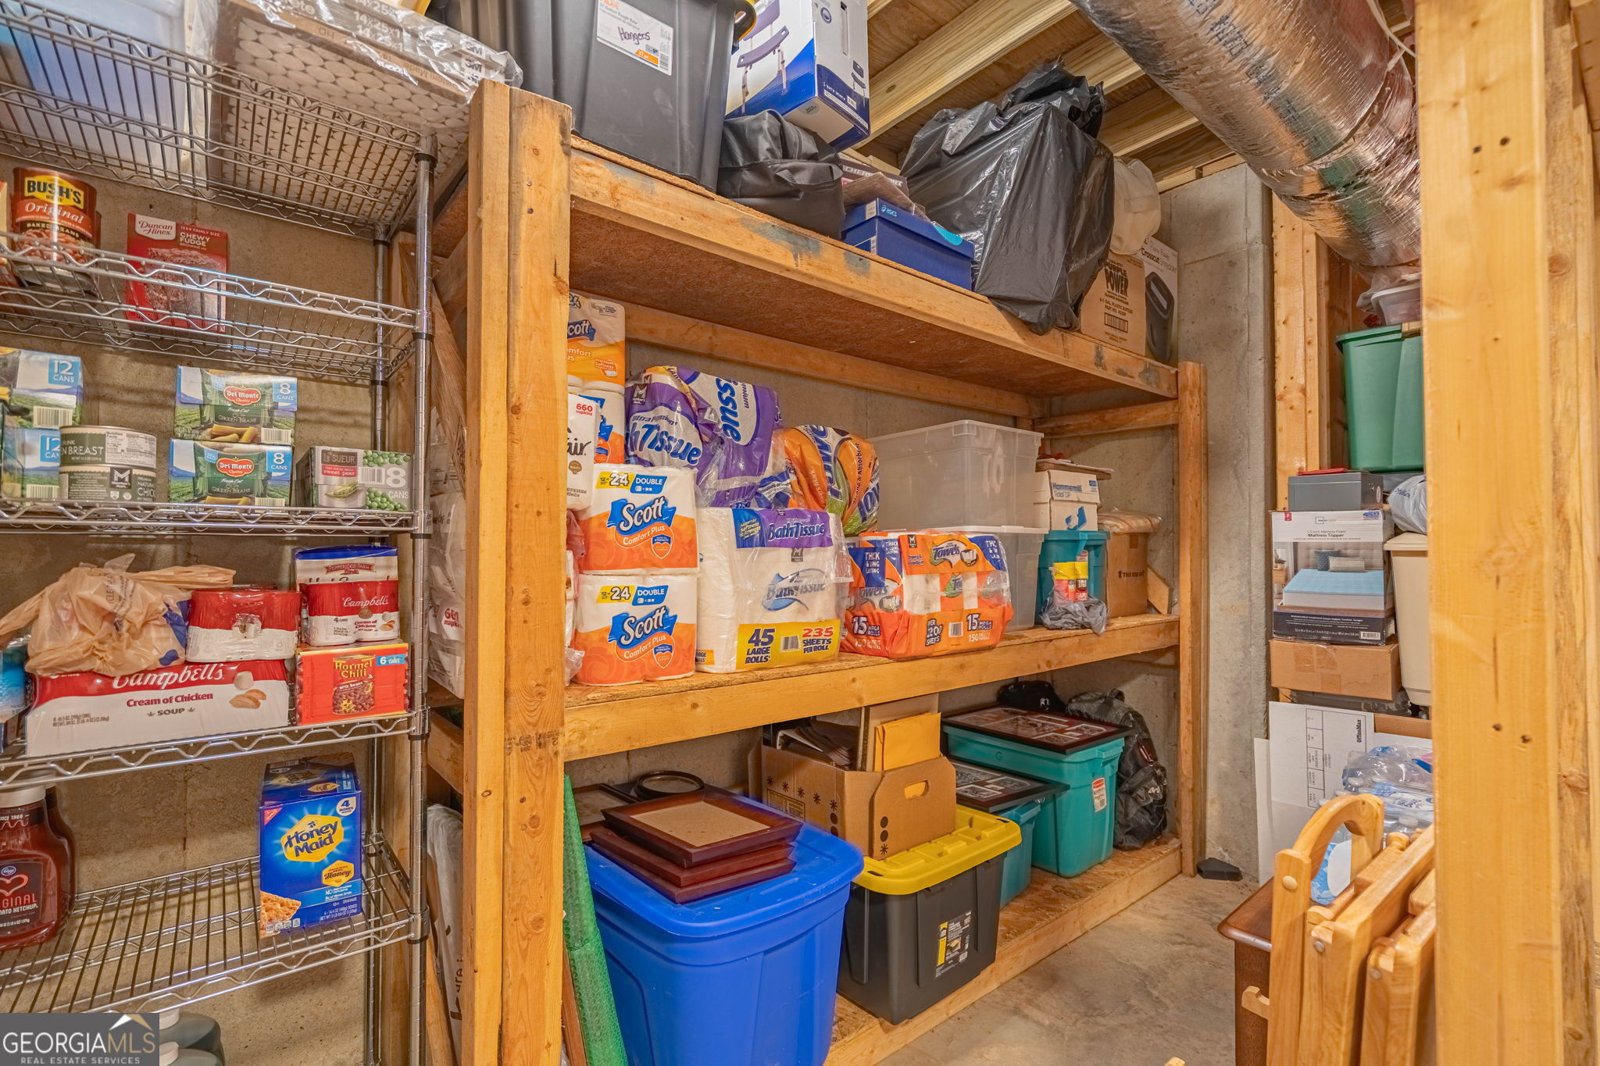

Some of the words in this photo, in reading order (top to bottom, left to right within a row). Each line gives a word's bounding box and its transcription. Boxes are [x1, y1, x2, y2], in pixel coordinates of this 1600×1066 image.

[617, 26, 651, 45] Hangers
[26, 180, 82, 205] BUSH'S
[26, 222, 52, 231] BAKE
[138, 220, 173, 231] Duncan
[143, 227, 171, 236] Hines
[180, 231, 210, 242] CHEWY
[180, 237, 207, 247] FUDGE
[567, 320, 590, 336] cott
[568, 348, 591, 357] mfort
[53, 360, 74, 376] 12
[53, 374, 75, 383] CANS
[279, 382, 291, 395] 8
[576, 403, 593, 412] 660
[715, 378, 741, 442] ssue
[45, 436, 60, 451] 12
[567, 437, 592, 456] air
[68, 446, 104, 456] BREAST
[273, 452, 285, 465] 8
[386, 467, 407, 488] 8
[609, 472, 630, 487] 24
[635, 477, 663, 485] DOUBLE
[388, 491, 409, 500] CANS
[619, 495, 666, 532] Scott
[622, 530, 651, 546] Comfort
[650, 525, 665, 535] Plus
[933, 544, 960, 561] Towels
[611, 586, 632, 600] 24
[637, 588, 665, 596] DOUBLE
[342, 595, 389, 608] Campbell's
[620, 605, 667, 645] Scott
[852, 616, 868, 635] 15
[966, 614, 980, 631] 15
[747, 628, 776, 647] 45
[802, 627, 834, 638] 235
[623, 642, 652, 660] Comfort
[652, 635, 667, 645] Plus
[802, 638, 832, 647] SHEETS
[746, 646, 771, 656] LARGE
[334, 658, 373, 671] Hormel
[379, 656, 387, 665] 6
[744, 655, 769, 664] ROLLS
[112, 663, 225, 690] Campbell's
[340, 668, 368, 679] Chili
[126, 698, 161, 707] Cream
[162, 696, 174, 704] of
[174, 693, 214, 703] Chicken
[157, 708, 186, 716] SOUP
[341, 799, 350, 807] 4
[284, 821, 338, 850] Honey
[294, 833, 334, 858] Maid
[1, 892, 37, 909] GINAL
[13, 903, 38, 913] KETCHUP
